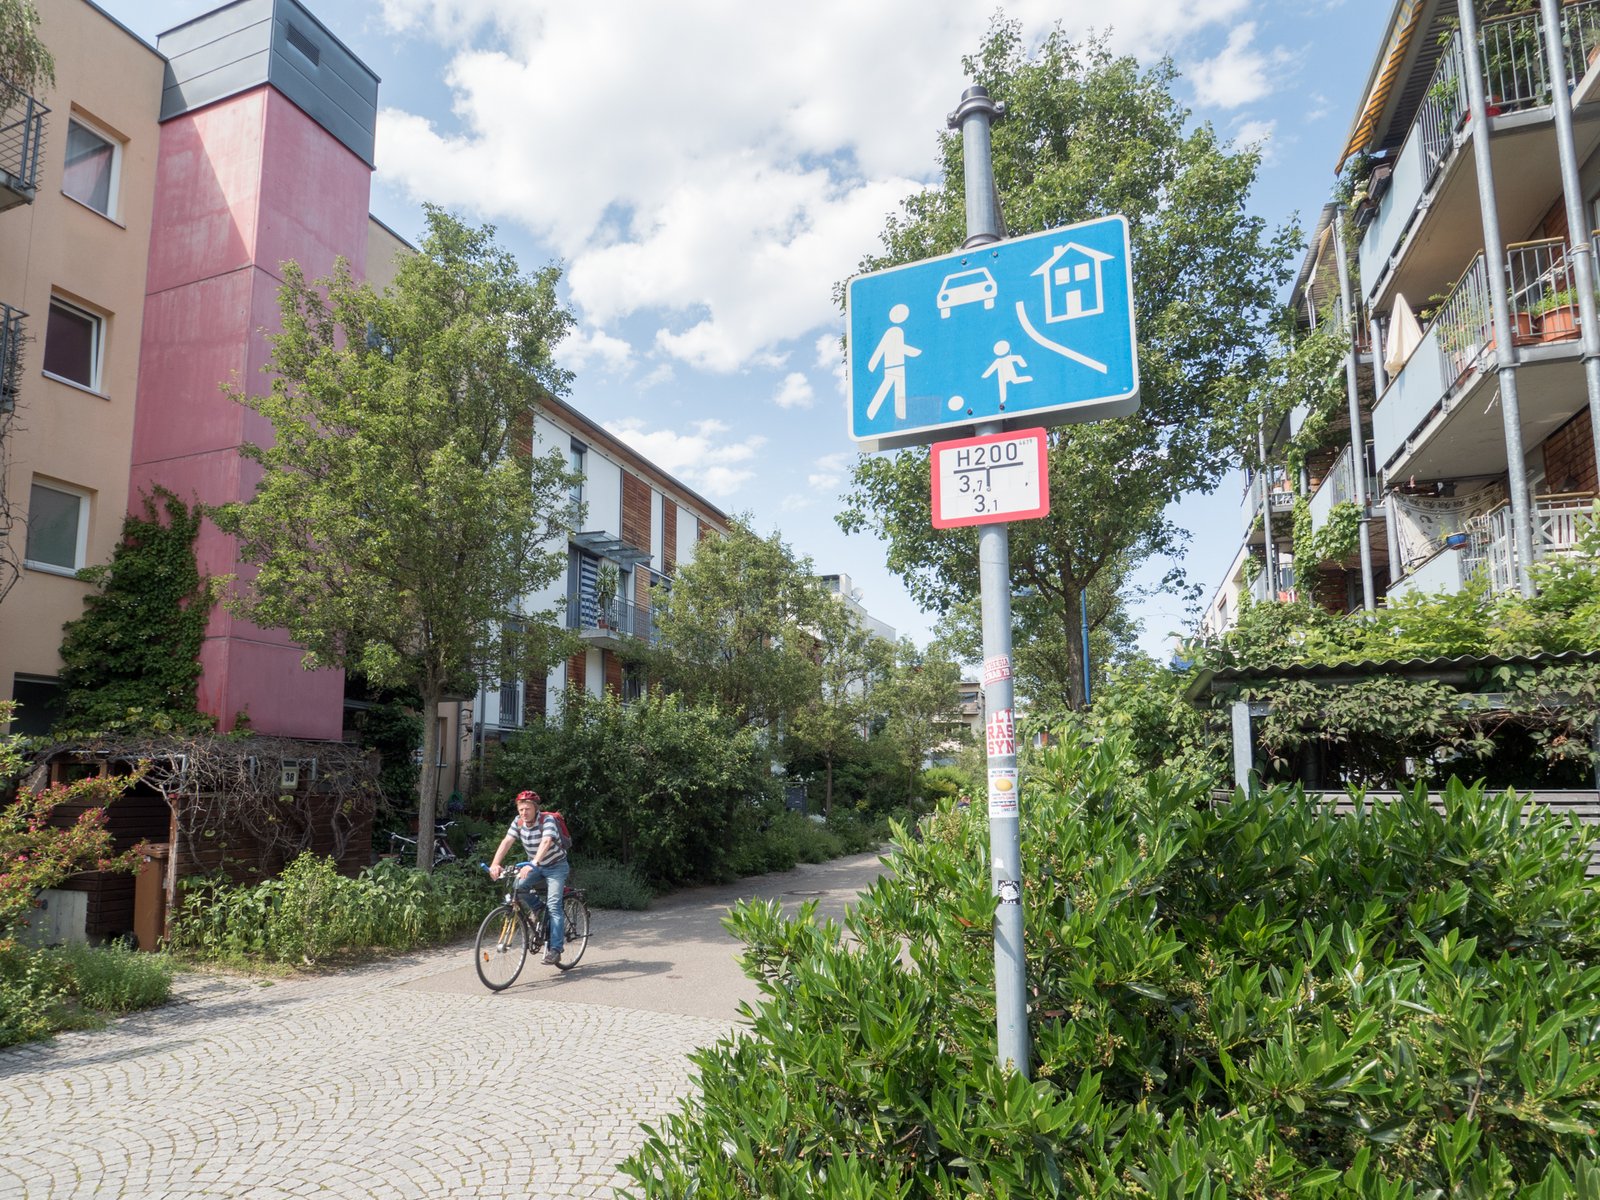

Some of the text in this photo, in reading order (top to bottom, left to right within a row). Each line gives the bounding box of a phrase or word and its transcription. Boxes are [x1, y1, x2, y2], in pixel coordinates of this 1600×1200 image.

[957, 442, 1017, 467] H200
[959, 474, 983, 493] 3,7
[974, 494, 998, 513] 3,1
[988, 724, 1014, 740] RAS
[989, 740, 1015, 755] SYN
[285, 772, 295, 783] 38
